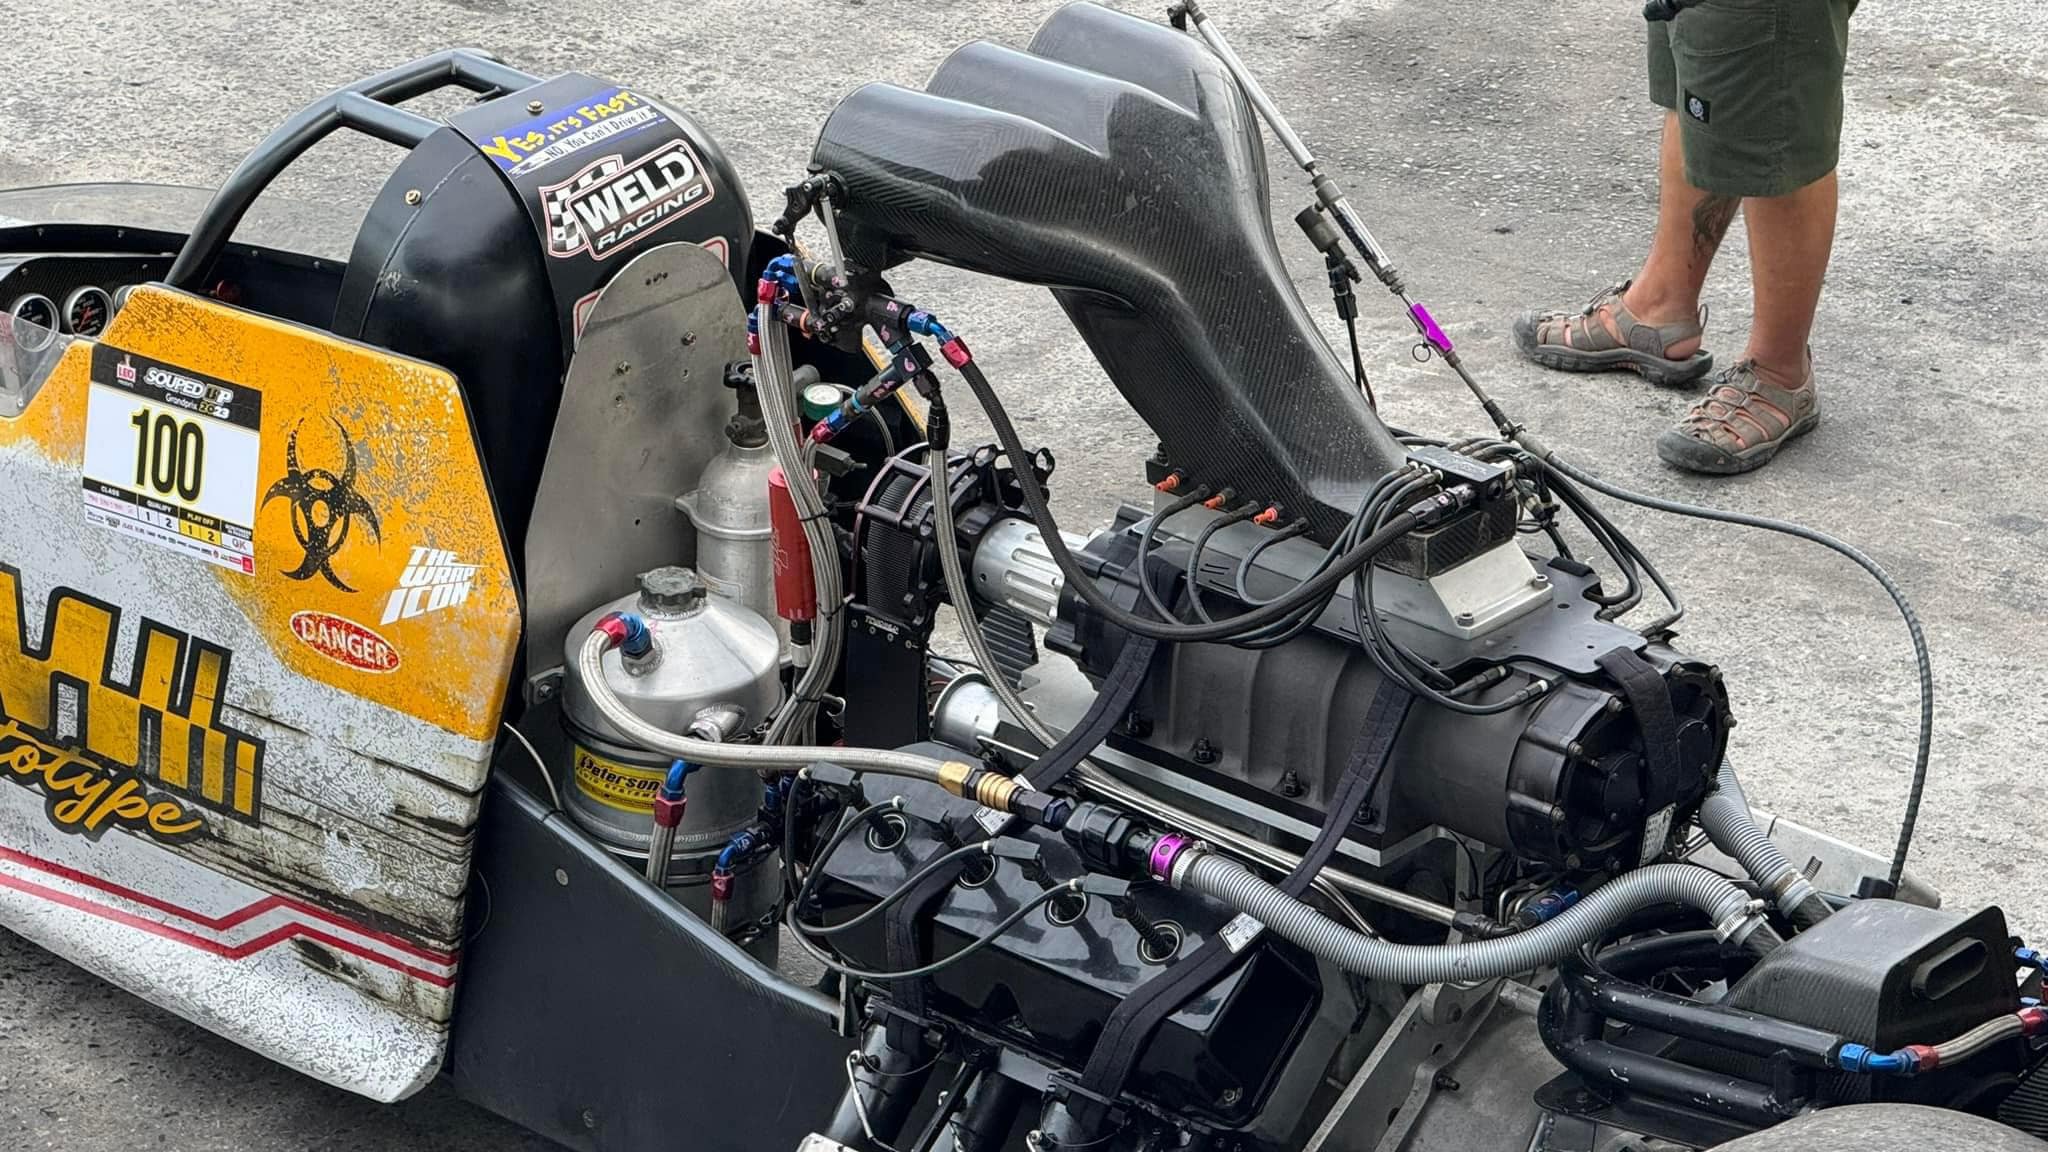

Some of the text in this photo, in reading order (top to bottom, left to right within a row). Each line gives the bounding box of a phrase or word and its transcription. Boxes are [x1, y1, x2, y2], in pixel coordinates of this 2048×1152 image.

[610, 115, 638, 130] Drive
[574, 151, 695, 233] WELD
[597, 183, 703, 250] RACING
[118, 367, 135, 381] LEO
[146, 369, 205, 397] SOUPED
[200, 401, 230, 419] 2023
[131, 408, 205, 502] 100
[101, 485, 120, 497] CLASS
[165, 517, 172, 528] 2
[207, 531, 215, 541] 2
[407, 545, 477, 568] THE
[379, 582, 472, 626] ICON
[299, 615, 390, 668] DANGER
[580, 755, 661, 791] Peterson
